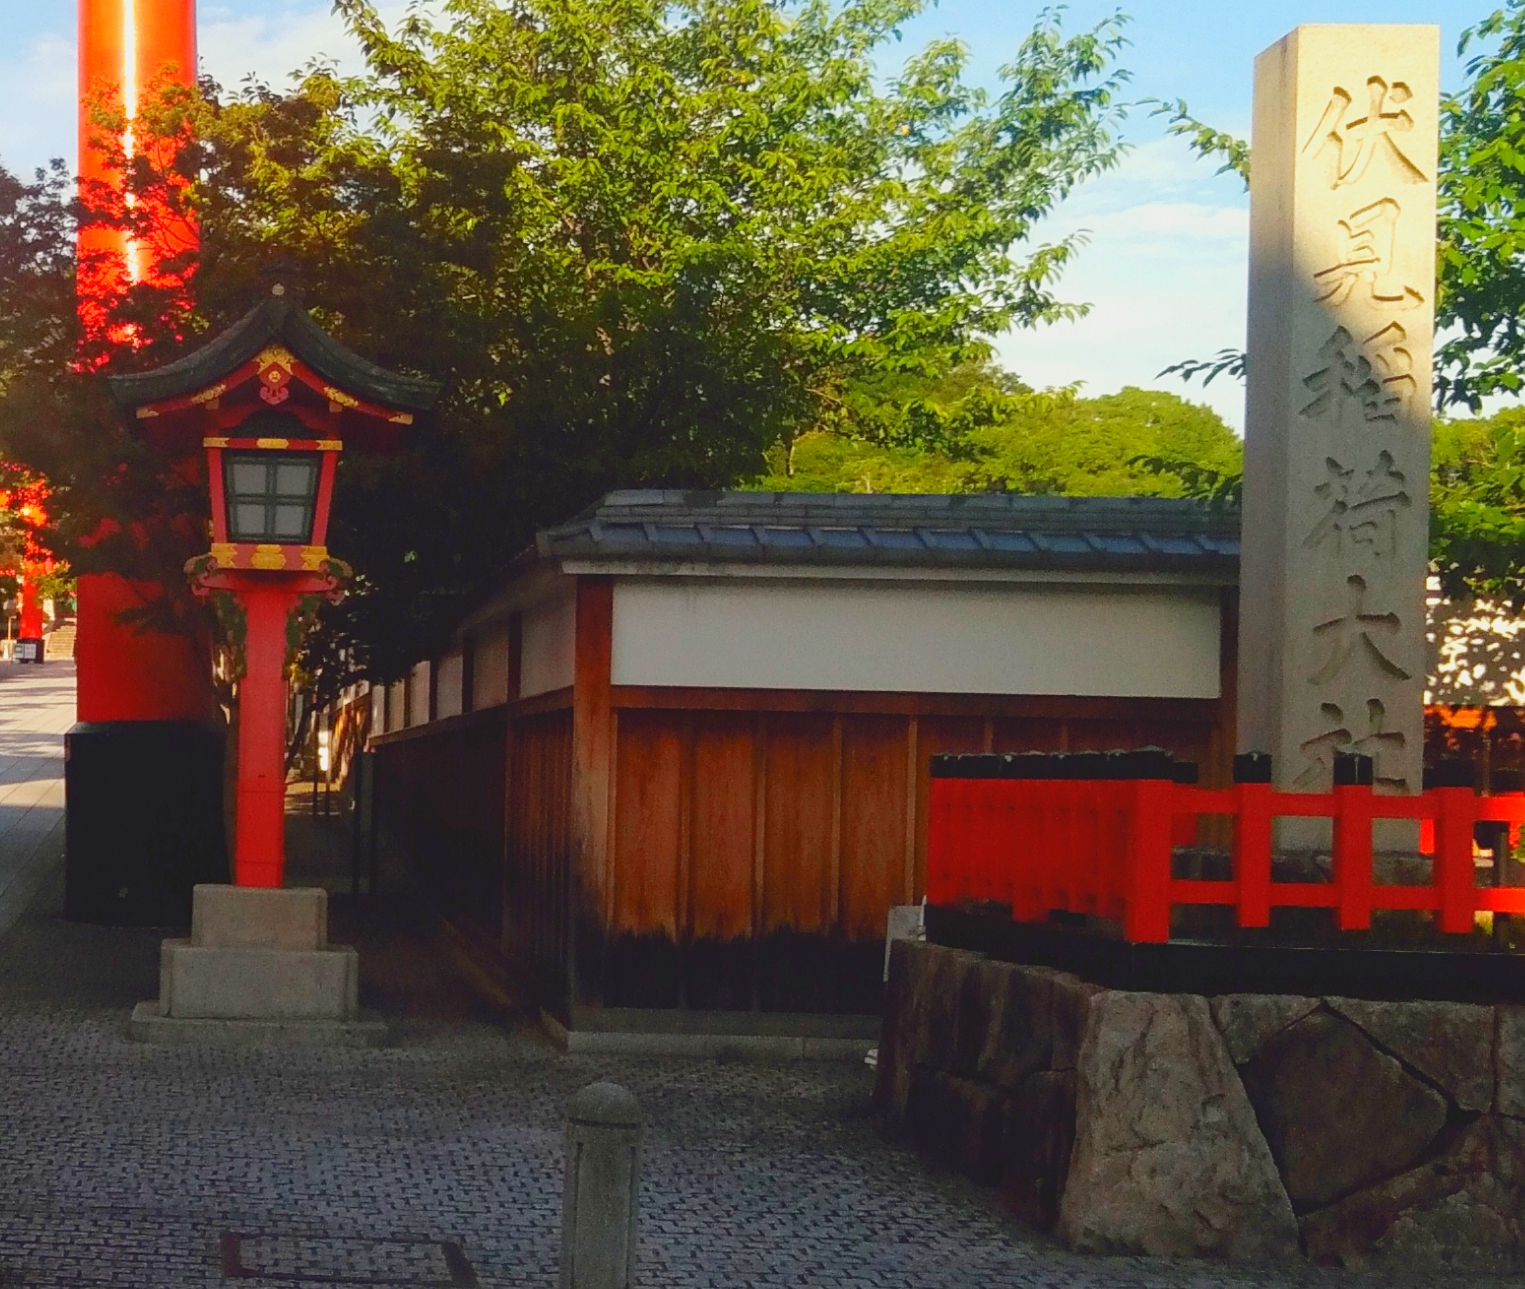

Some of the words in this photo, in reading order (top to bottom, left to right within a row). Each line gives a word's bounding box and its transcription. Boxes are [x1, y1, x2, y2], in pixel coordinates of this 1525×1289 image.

[1293, 74, 1429, 795] 伏見稲荷大社
